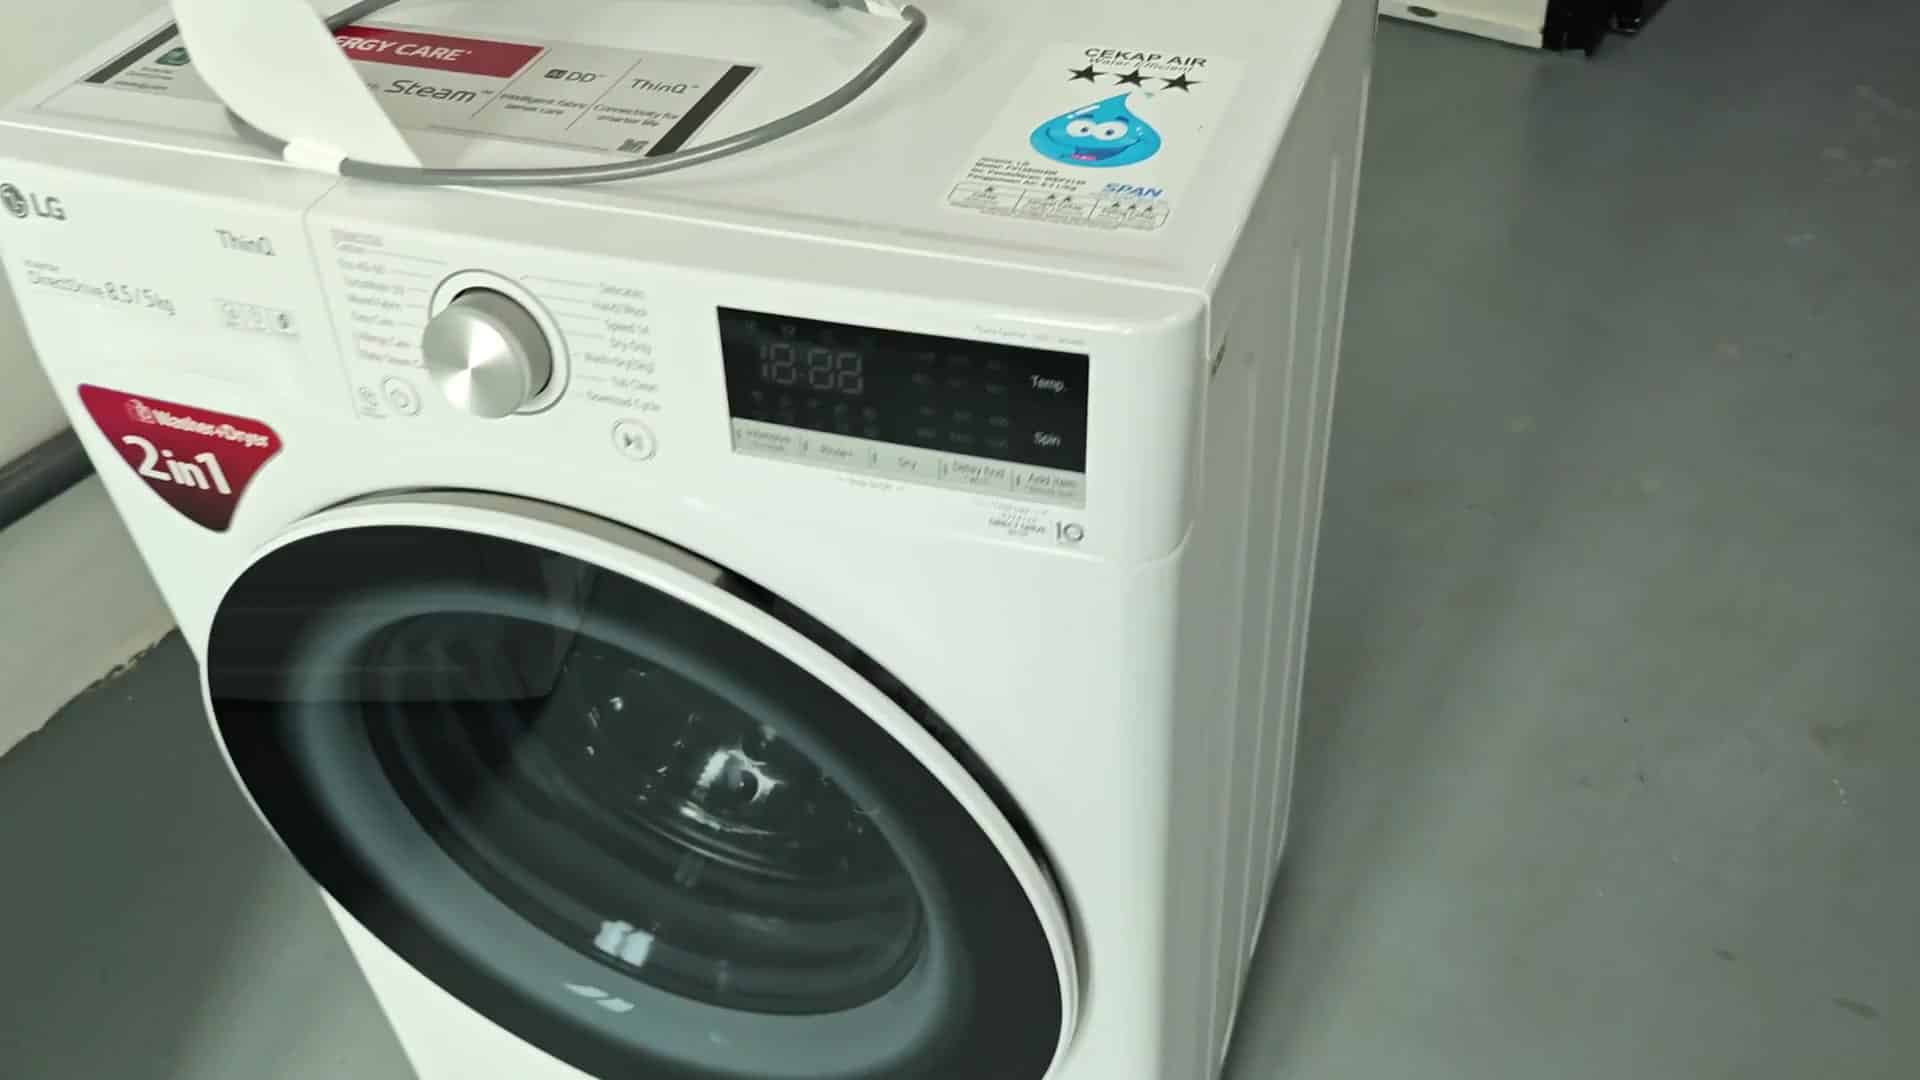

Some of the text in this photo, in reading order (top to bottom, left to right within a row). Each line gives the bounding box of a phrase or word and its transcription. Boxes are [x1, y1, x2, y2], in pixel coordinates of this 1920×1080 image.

[335, 36, 466, 61] ERGY CARE
[1084, 48, 1207, 67] CEKAP AIR
[384, 80, 477, 104] Steam
[631, 79, 688, 95] ThinQ
[1102, 183, 1164, 198] SPAN
[29, 192, 67, 221] LG
[1033, 429, 1061, 447] Spin
